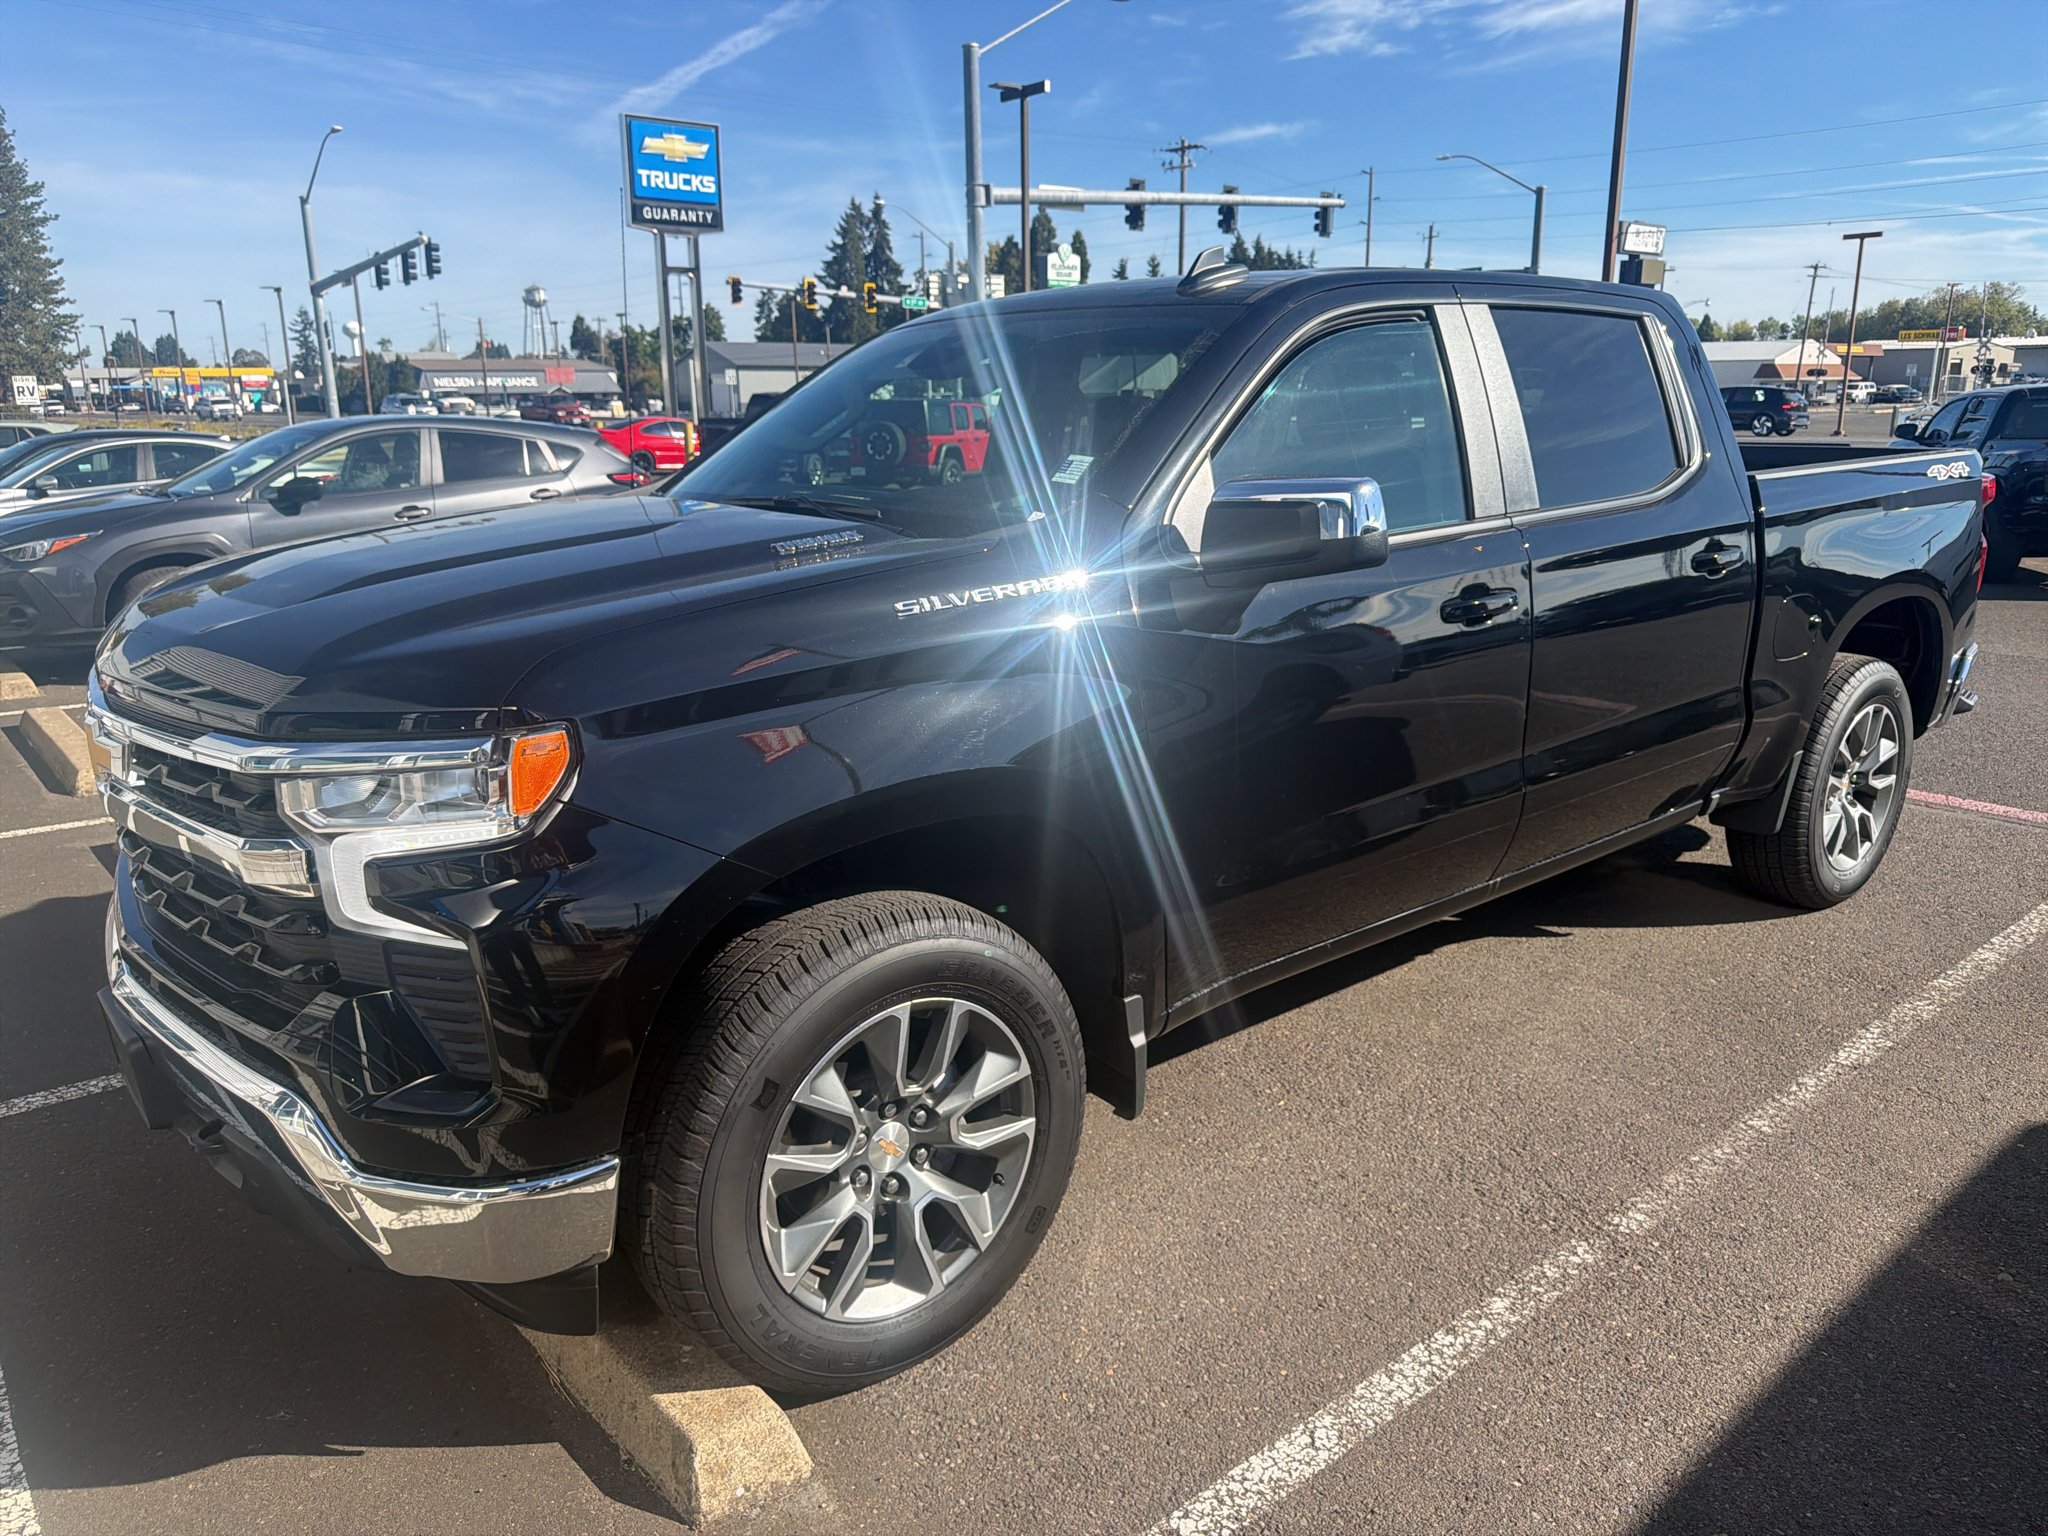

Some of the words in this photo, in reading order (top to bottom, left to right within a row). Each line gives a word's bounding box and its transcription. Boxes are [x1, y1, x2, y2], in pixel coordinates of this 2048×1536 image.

[637, 168, 716, 193] TRUCKS
[642, 206, 715, 224] GUARANTY
[1900, 332, 1912, 340] LES
[1913, 331, 1940, 340] SCHWAB
[432, 376, 475, 387] NIELSEN
[16, 385, 35, 397] RV
[893, 571, 1088, 617] SILVERAD
